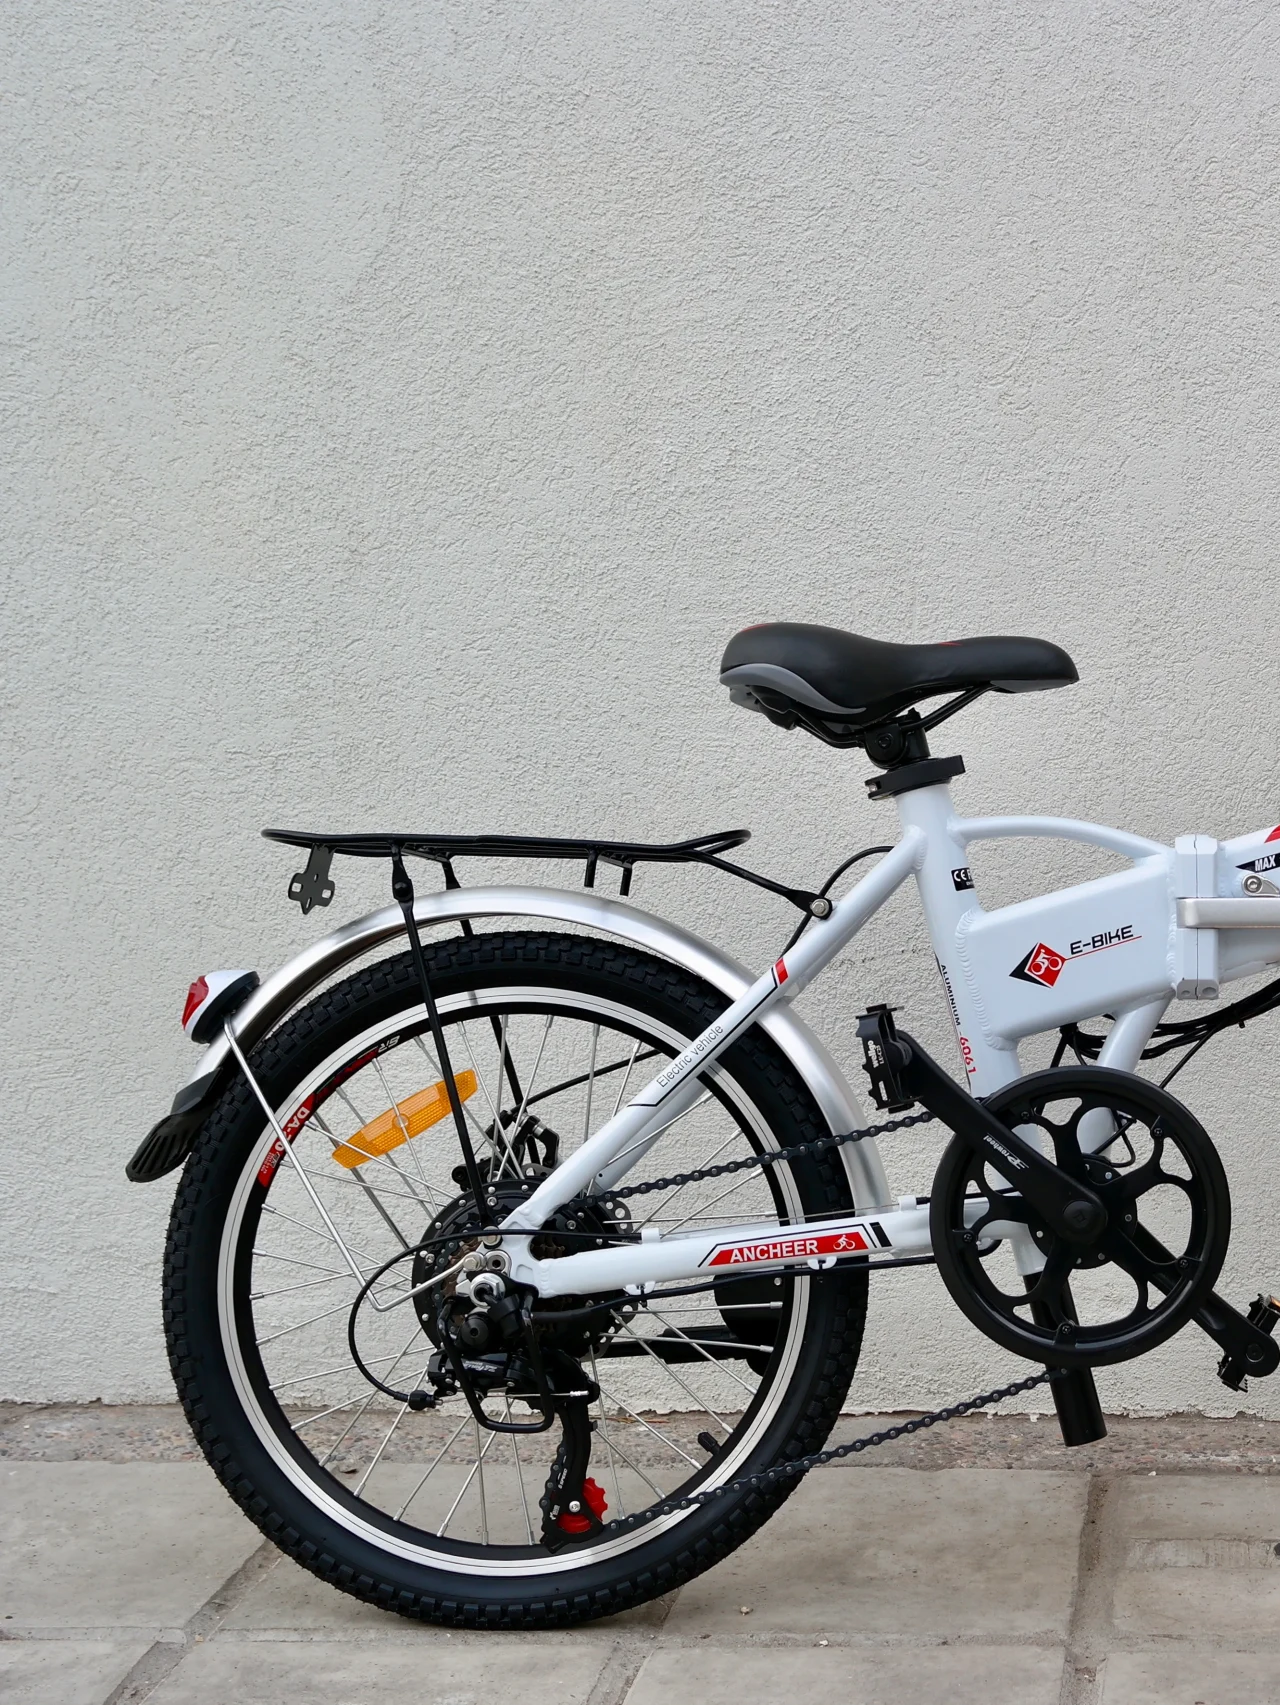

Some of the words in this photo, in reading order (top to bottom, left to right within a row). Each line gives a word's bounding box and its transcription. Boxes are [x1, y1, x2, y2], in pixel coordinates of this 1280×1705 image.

[1254, 854, 1276, 872] MAX
[1069, 924, 1134, 956] E-BIKE
[940, 964, 961, 1026] ALUMINIUM
[656, 1054, 693, 1088] Electric
[690, 1025, 724, 1056] vehicle
[729, 1239, 819, 1263] ANCHEER
